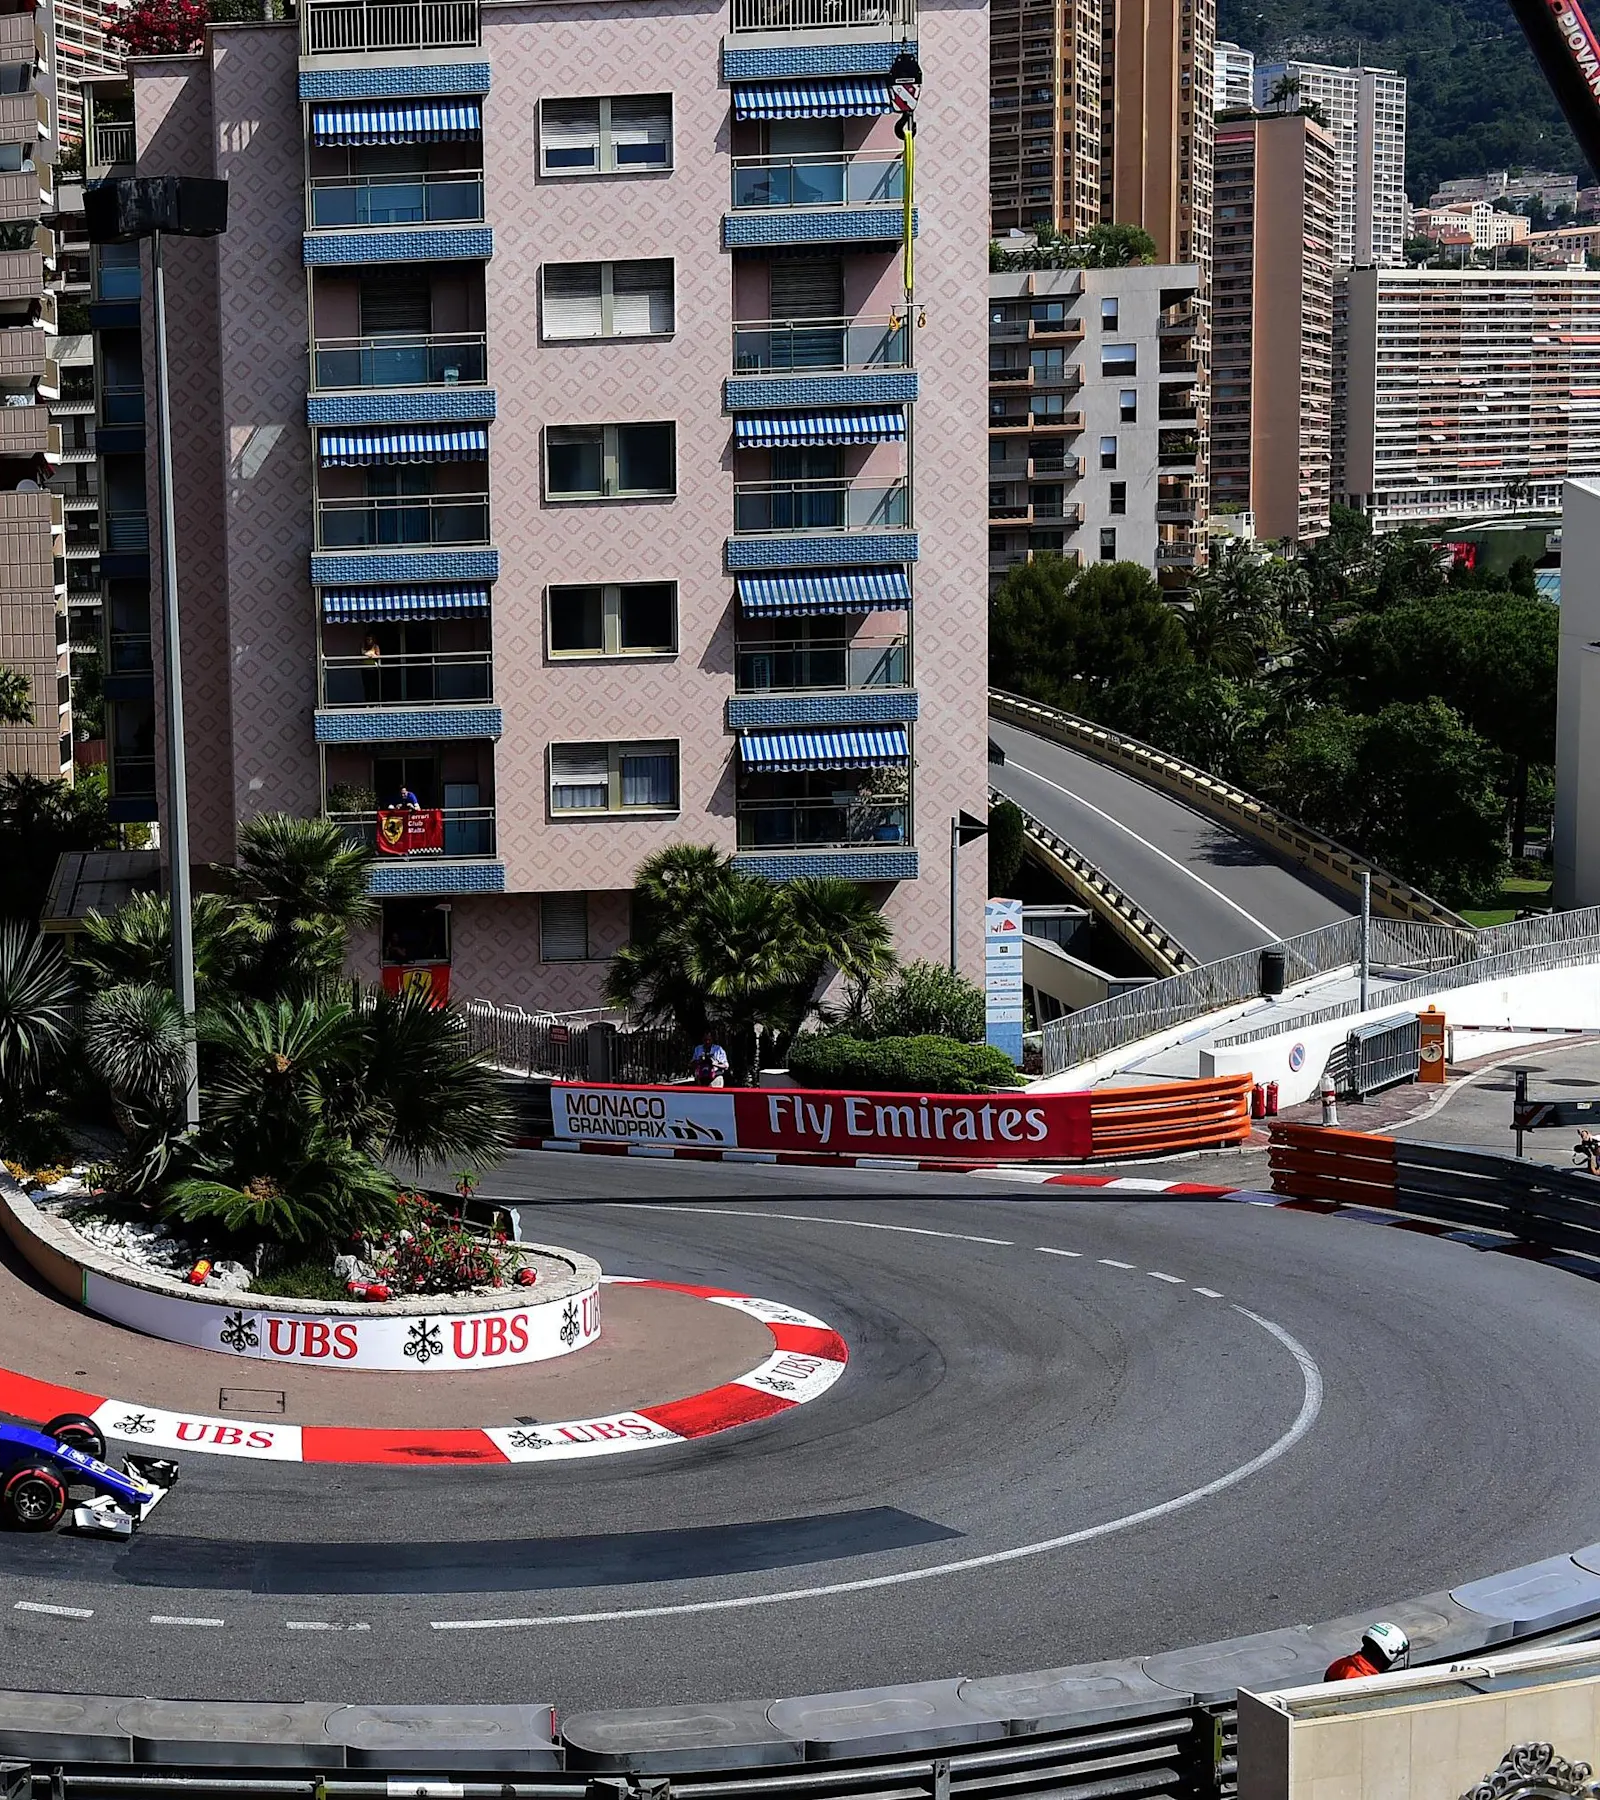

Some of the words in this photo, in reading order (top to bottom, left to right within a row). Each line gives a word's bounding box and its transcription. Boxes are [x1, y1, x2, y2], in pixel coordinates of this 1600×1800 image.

[1557, 11, 1600, 103] PIOVAN
[566, 1094, 665, 1118] MONACO
[767, 1095, 832, 1143] Fly
[843, 1097, 1048, 1141] Emirates
[579, 1117, 667, 1138] GRANDPRIX
[267, 1319, 358, 1360] UBS
[451, 1314, 529, 1359] UBS
[771, 1354, 822, 1379] UBS
[176, 1421, 274, 1449] UBS
[553, 1418, 652, 1443] UBS
